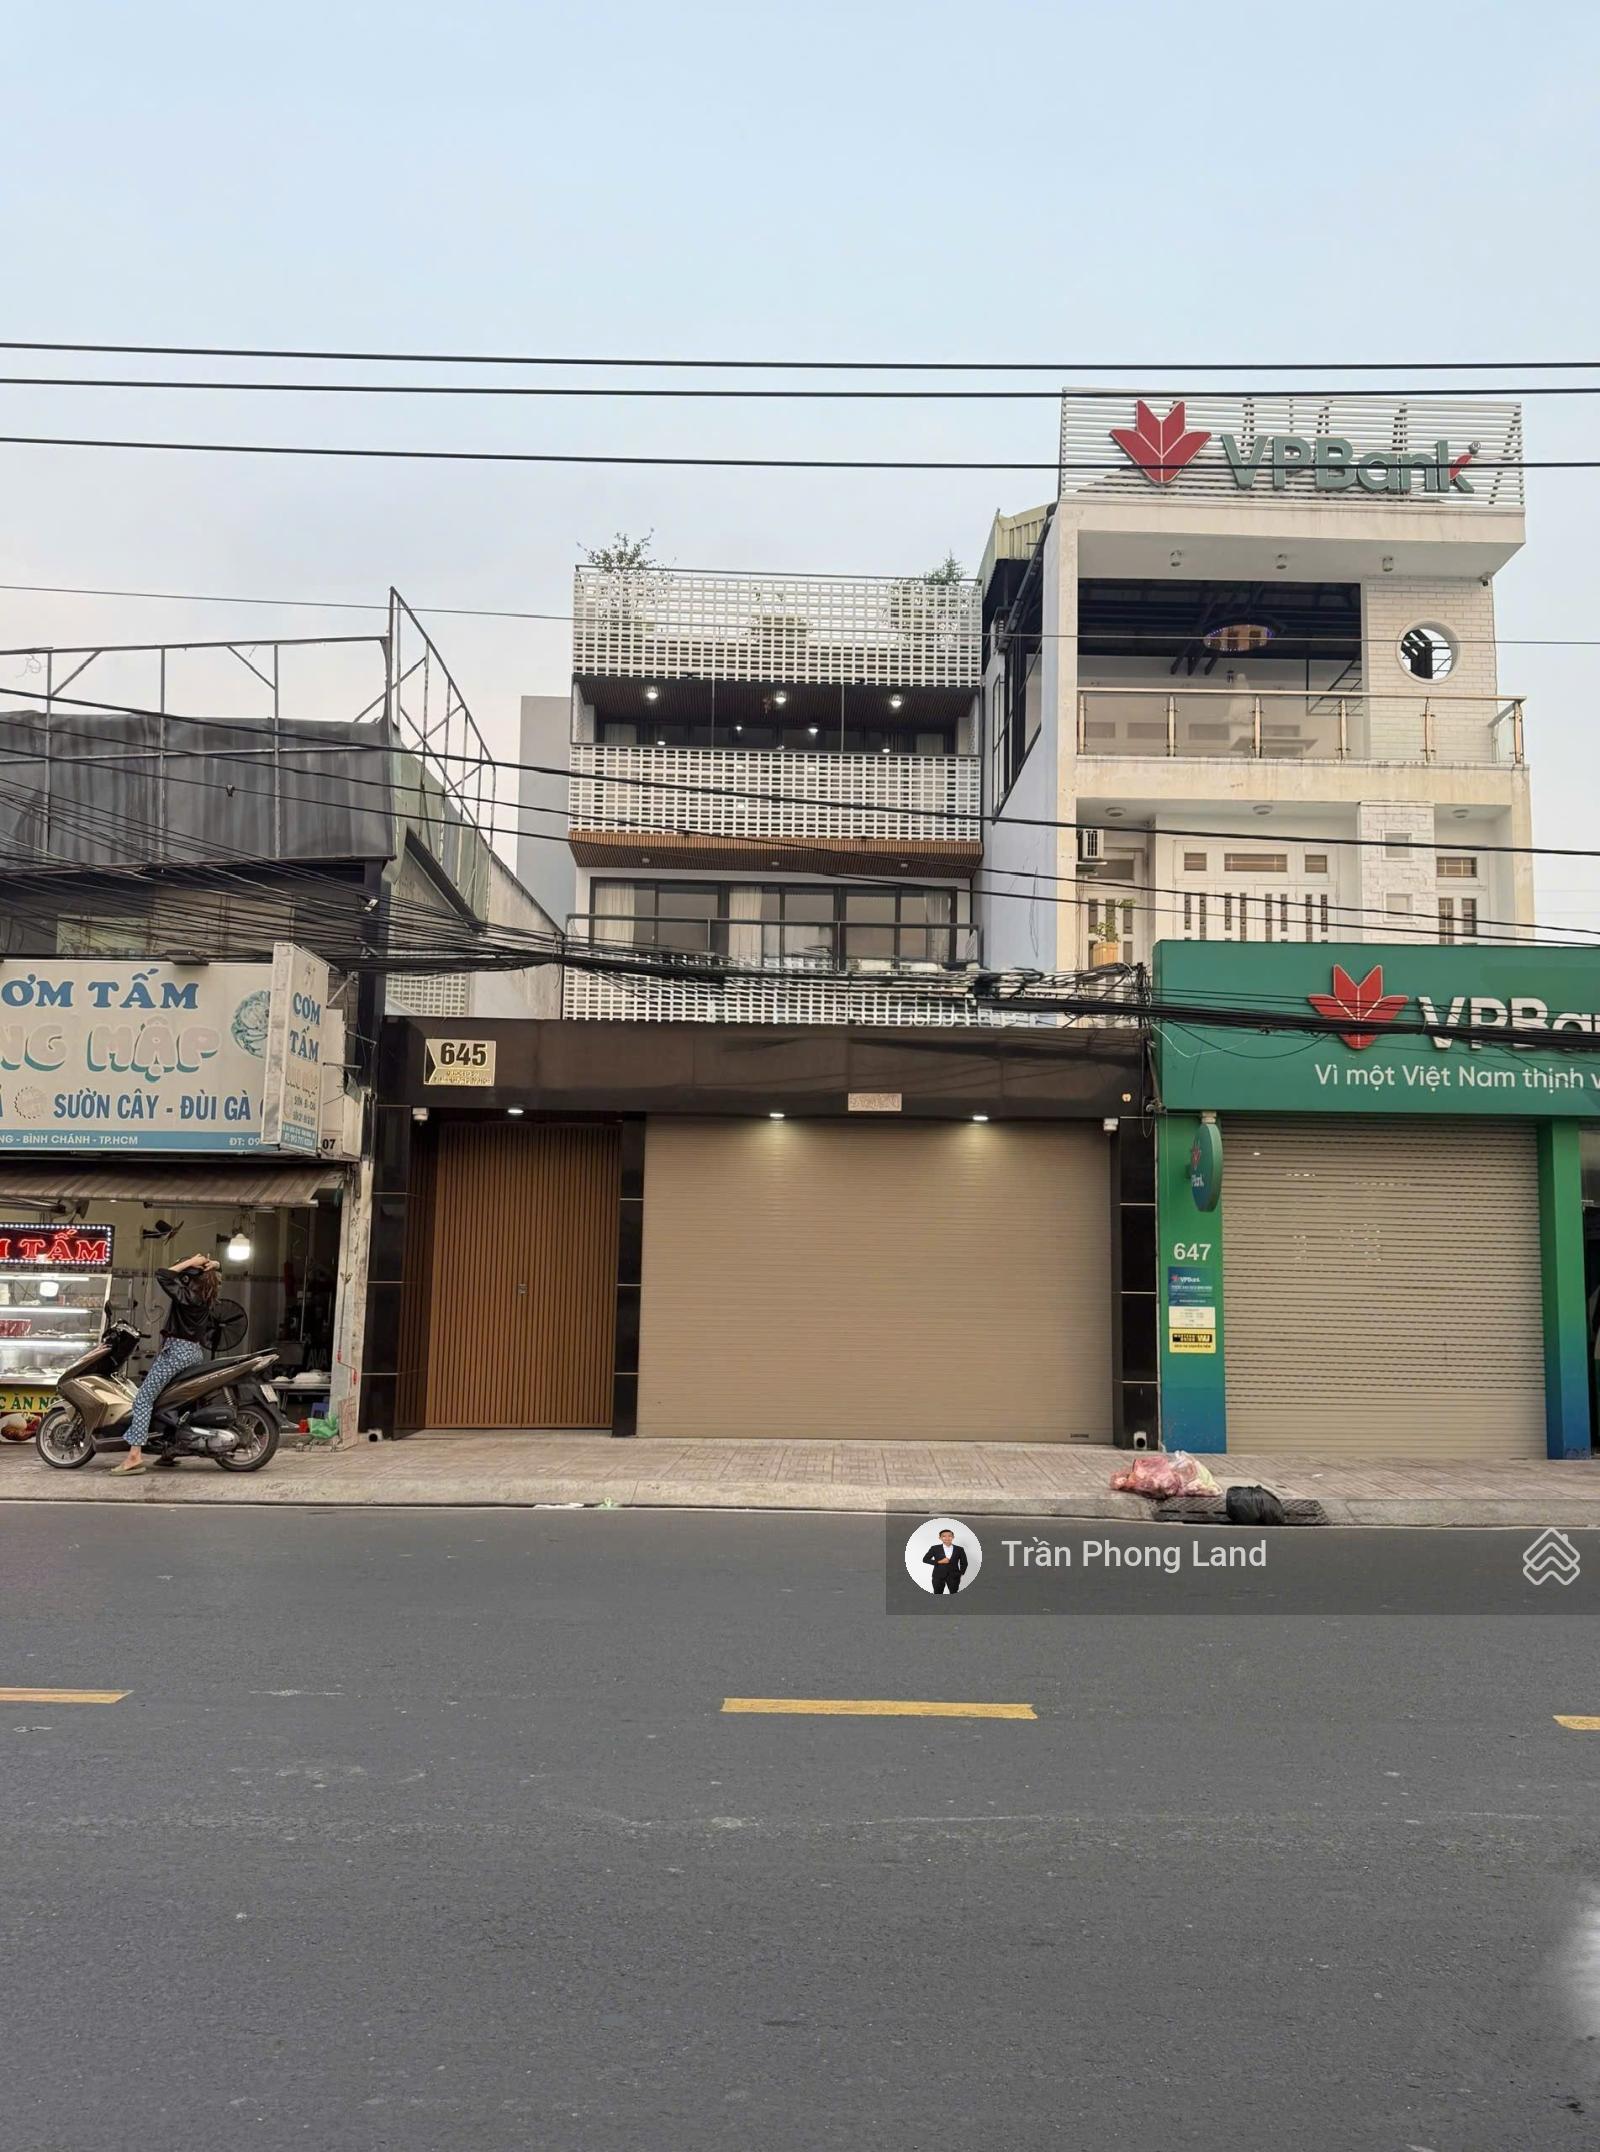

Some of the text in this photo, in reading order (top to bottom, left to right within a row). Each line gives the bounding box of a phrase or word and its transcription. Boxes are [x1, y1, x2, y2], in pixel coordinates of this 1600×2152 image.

[1221, 433, 1474, 493] VPBank
[88, 969, 199, 1009] TẤM
[292, 992, 321, 1026] CƠM
[289, 1026, 319, 1063] TẤM
[440, 1042, 487, 1067] 645
[1315, 1064, 1338, 1086] Vì
[1346, 1066, 1396, 1091] một
[1402, 1065, 1451, 1092] Việt
[1459, 1066, 1516, 1088] Nam
[1522, 1067, 1584, 1093] thịnh
[53, 1088, 110, 1119] SƯỜN
[117, 1088, 159, 1120] CÂY
[180, 1090, 217, 1120] ĐÙI
[224, 1090, 251, 1121] GÀ
[23, 1132, 48, 1145] BÌNH
[51, 1133, 90, 1145] CHÁNH
[100, 1135, 138, 1145] TP.HCM
[229, 1137, 245, 1146] ĐT:
[322, 1138, 336, 1150] 07
[20, 1229, 107, 1261] TẤM
[1173, 1243, 1212, 1261] 647
[11, 1392, 33, 1410] ĂN
